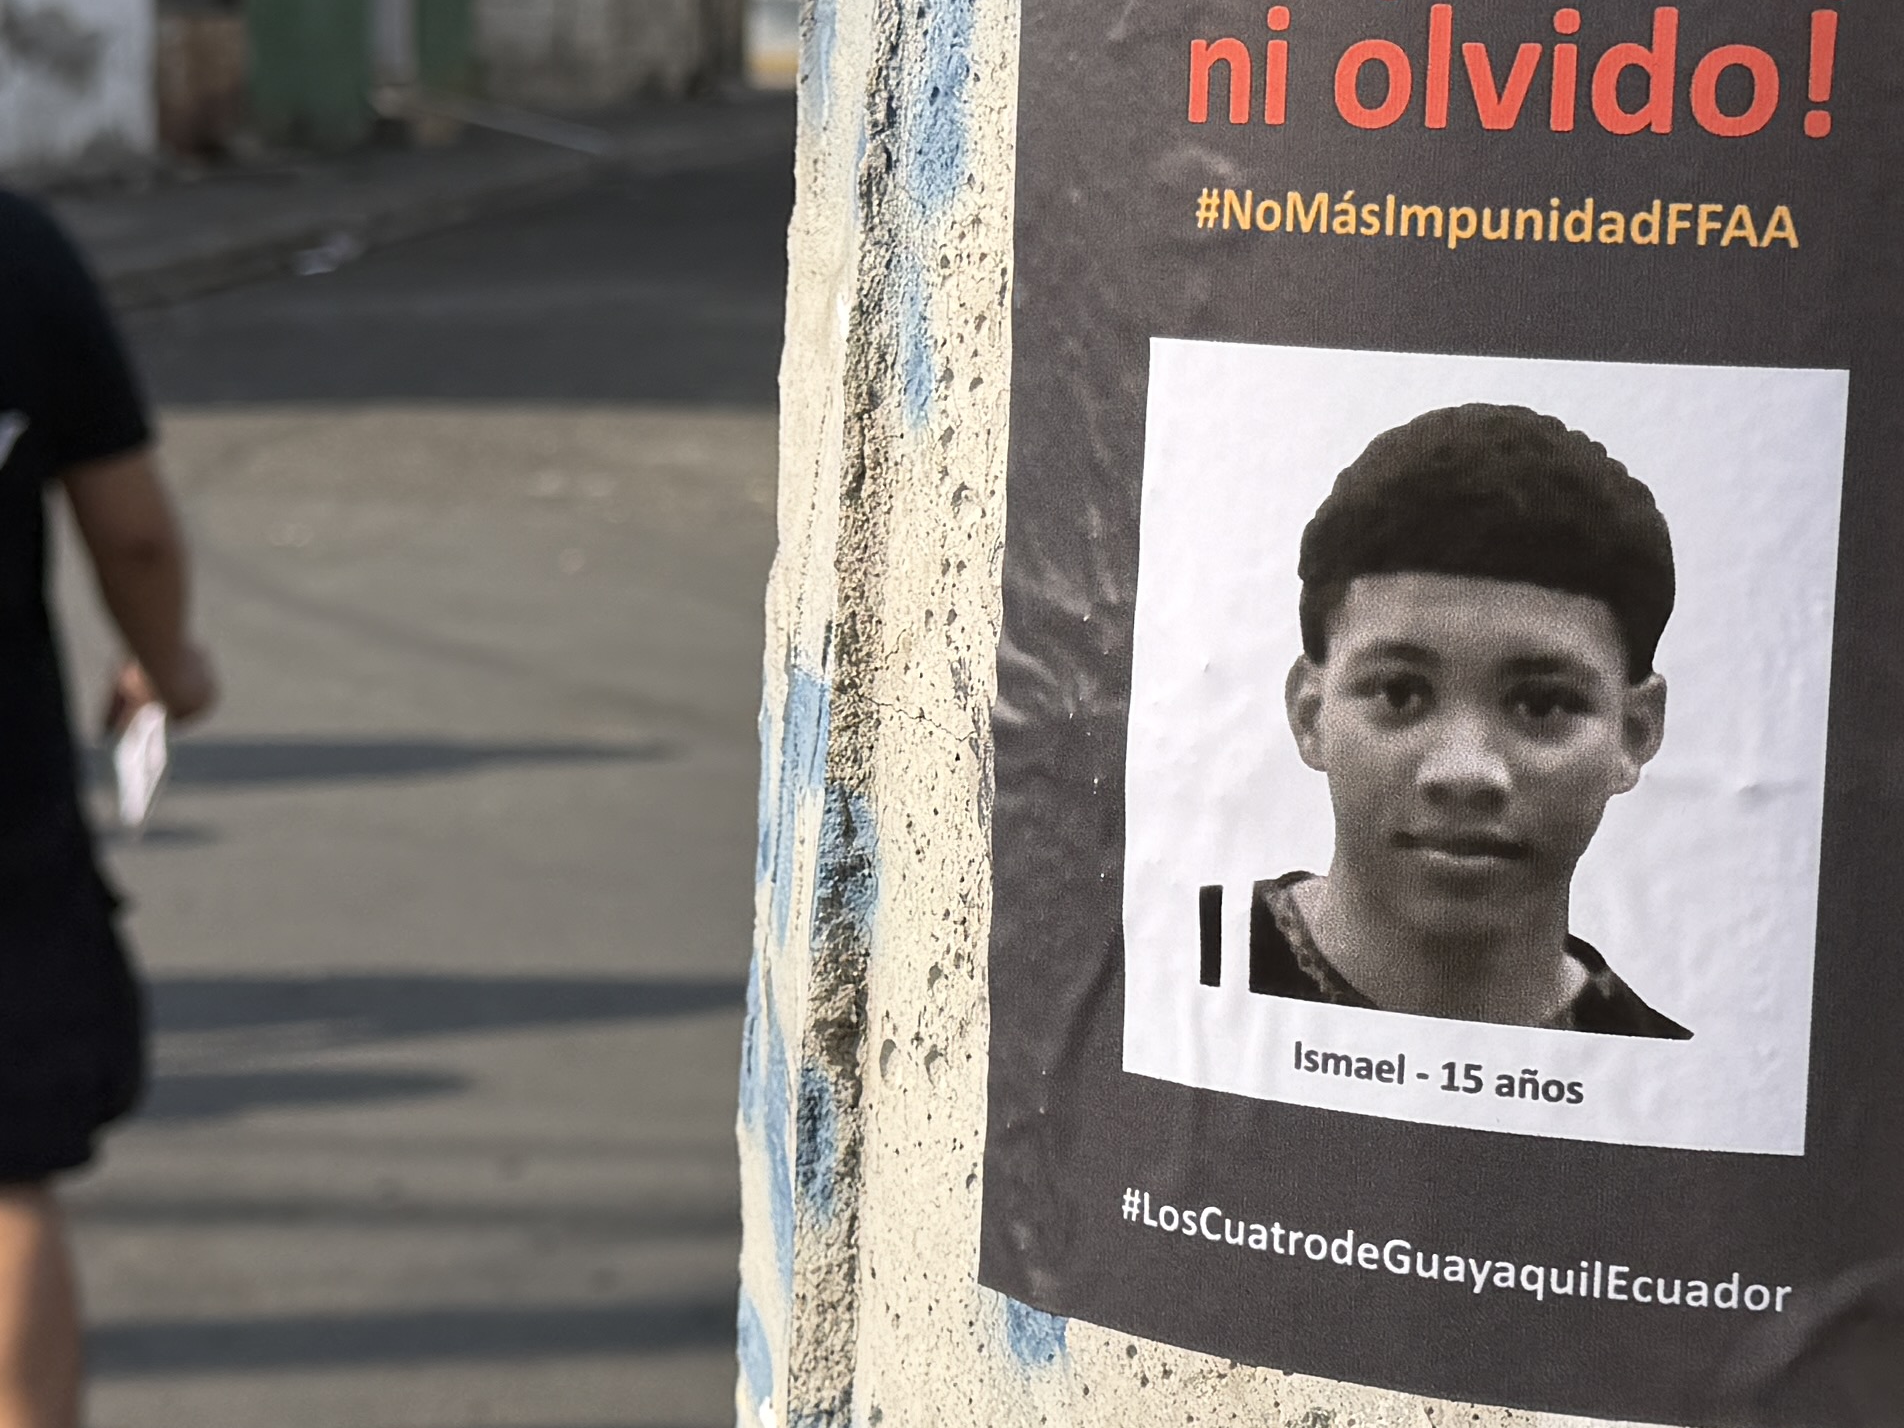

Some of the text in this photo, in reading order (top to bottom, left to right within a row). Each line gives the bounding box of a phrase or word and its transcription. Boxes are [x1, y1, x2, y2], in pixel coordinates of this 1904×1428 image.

[1187, 2, 1839, 139] ni olvido!
[1195, 187, 1801, 251] #NoMásImpunidadFFAA
[1293, 1040, 1406, 1086] Ismael
[1440, 1060, 1485, 1095] 15
[1494, 1067, 1585, 1105] años
[1120, 1186, 1794, 1314] #LosCuatrodeGuayaquilEcuador
